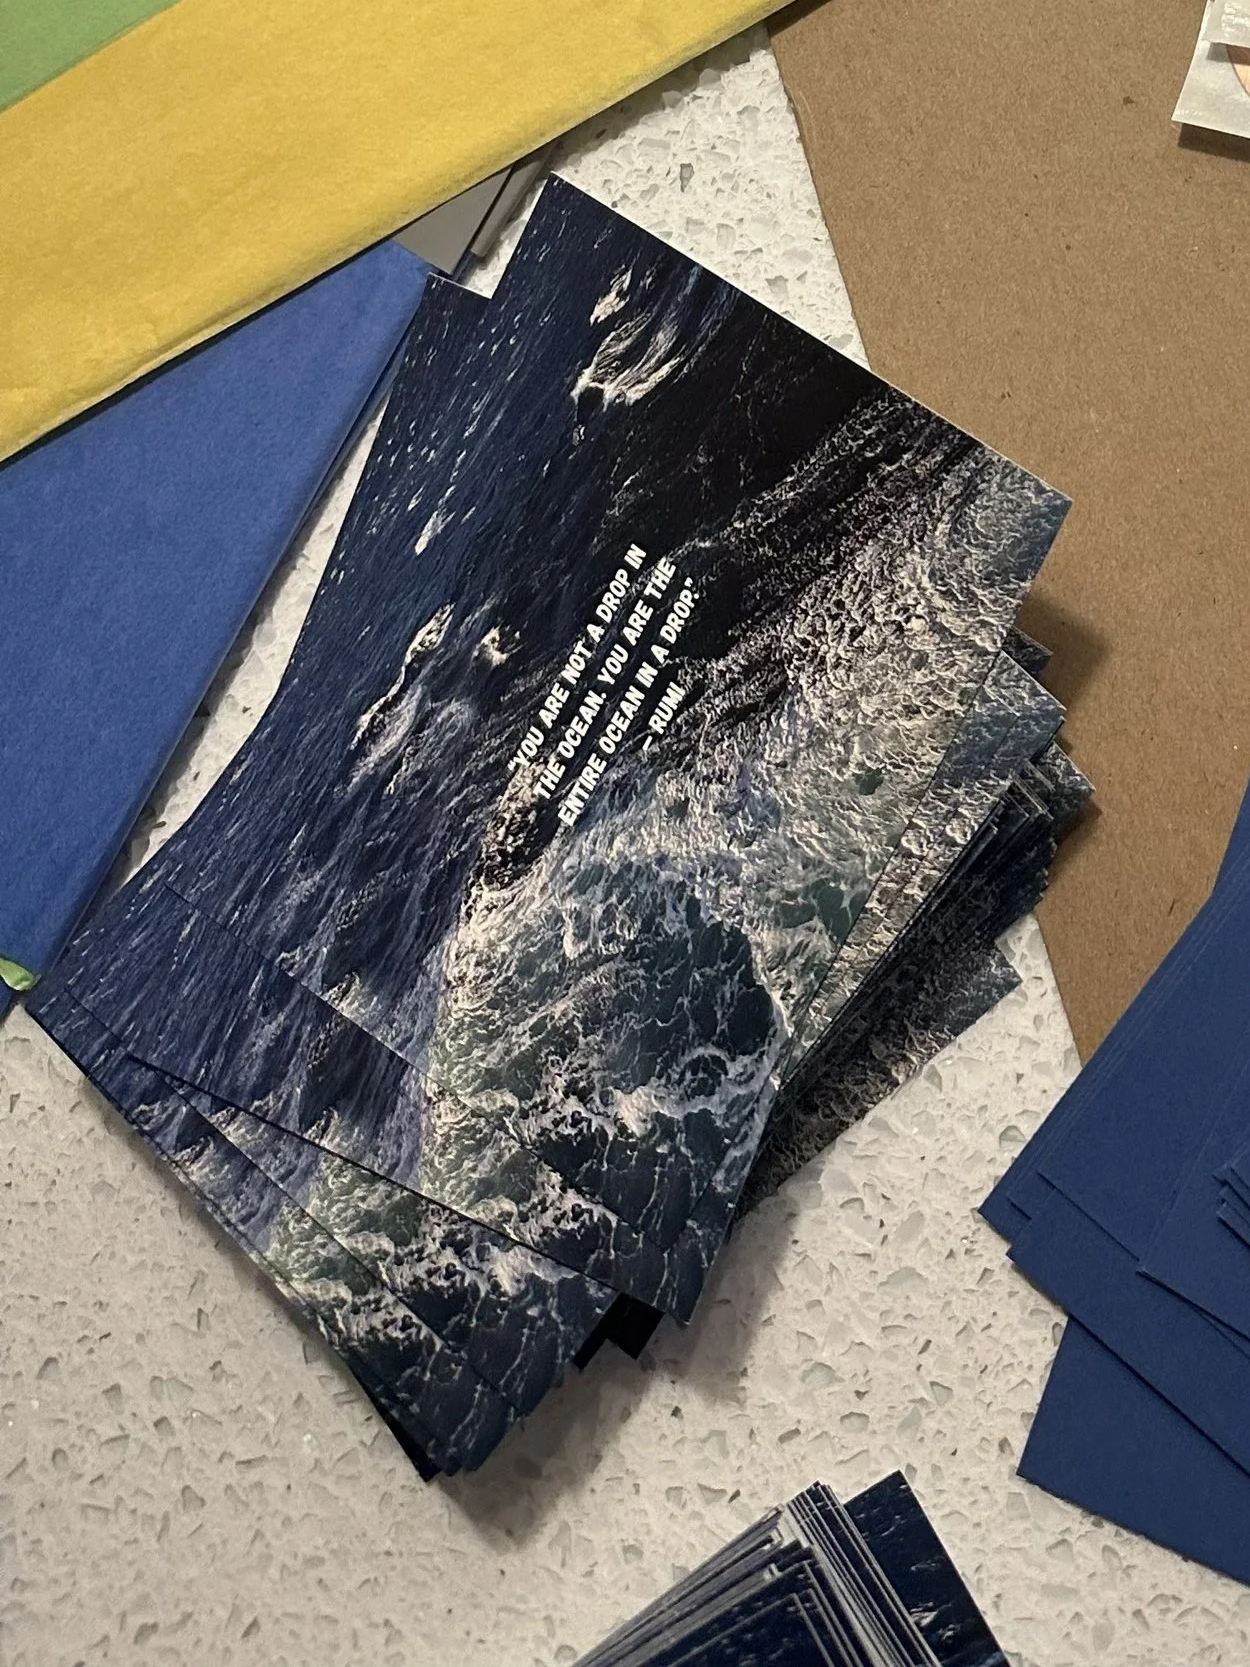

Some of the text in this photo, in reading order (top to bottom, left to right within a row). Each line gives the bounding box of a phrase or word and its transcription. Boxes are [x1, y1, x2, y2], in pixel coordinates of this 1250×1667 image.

[534, 557, 677, 800] THE OCEAN. YOU ARE THE
[538, 682, 570, 728] ARE
[561, 640, 593, 685] NOT
[586, 623, 605, 643] A
[596, 568, 631, 624] DROP
[624, 543, 647, 570] IN
[648, 681, 687, 735] RUMI
[557, 752, 608, 827] ENTIRE
[598, 685, 646, 755] OCEAN
[634, 661, 658, 689] IN
[650, 644, 670, 664] A
